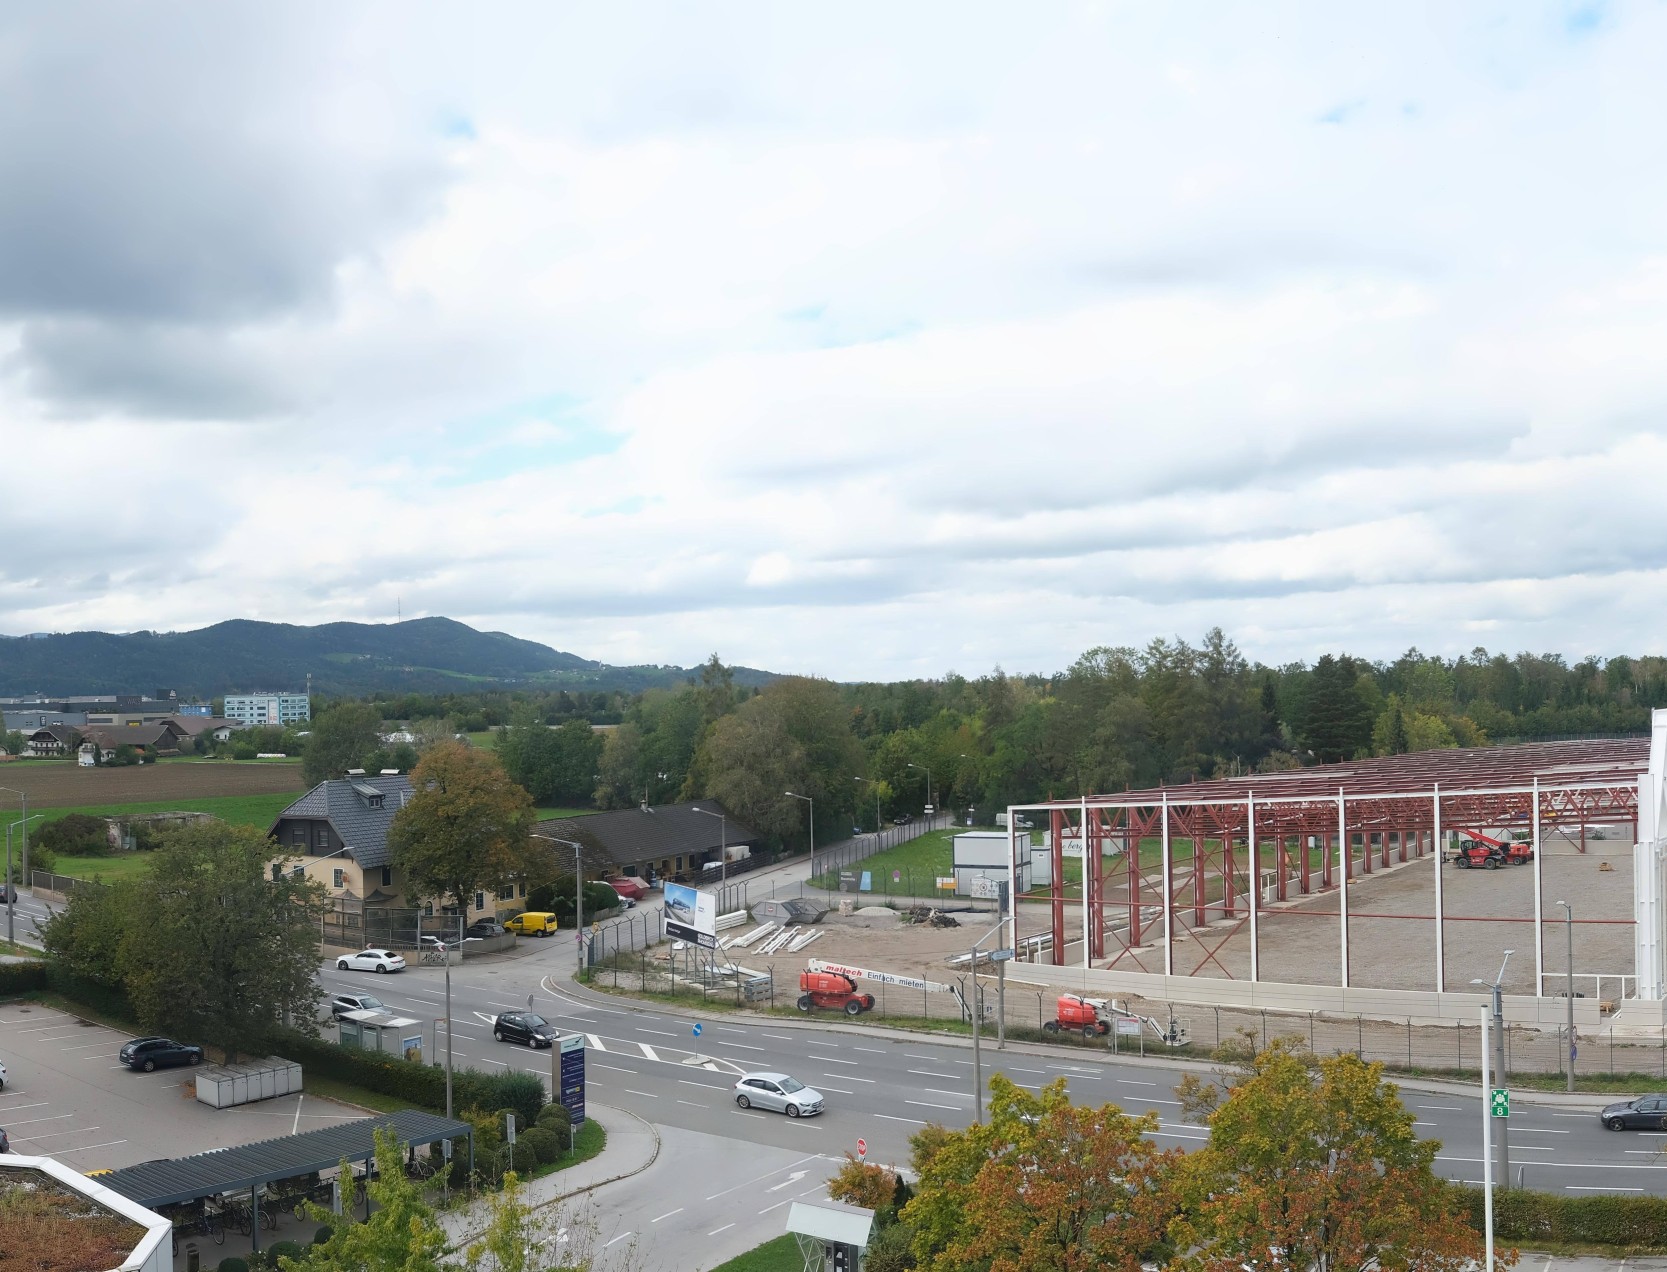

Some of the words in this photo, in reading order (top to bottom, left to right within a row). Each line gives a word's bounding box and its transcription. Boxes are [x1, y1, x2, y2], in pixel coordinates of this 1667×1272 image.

[826, 965, 862, 976] maltech
[867, 972, 895, 983] Einfach
[899, 979, 924, 989] mieten
[1497, 1107, 1503, 1115] 8
